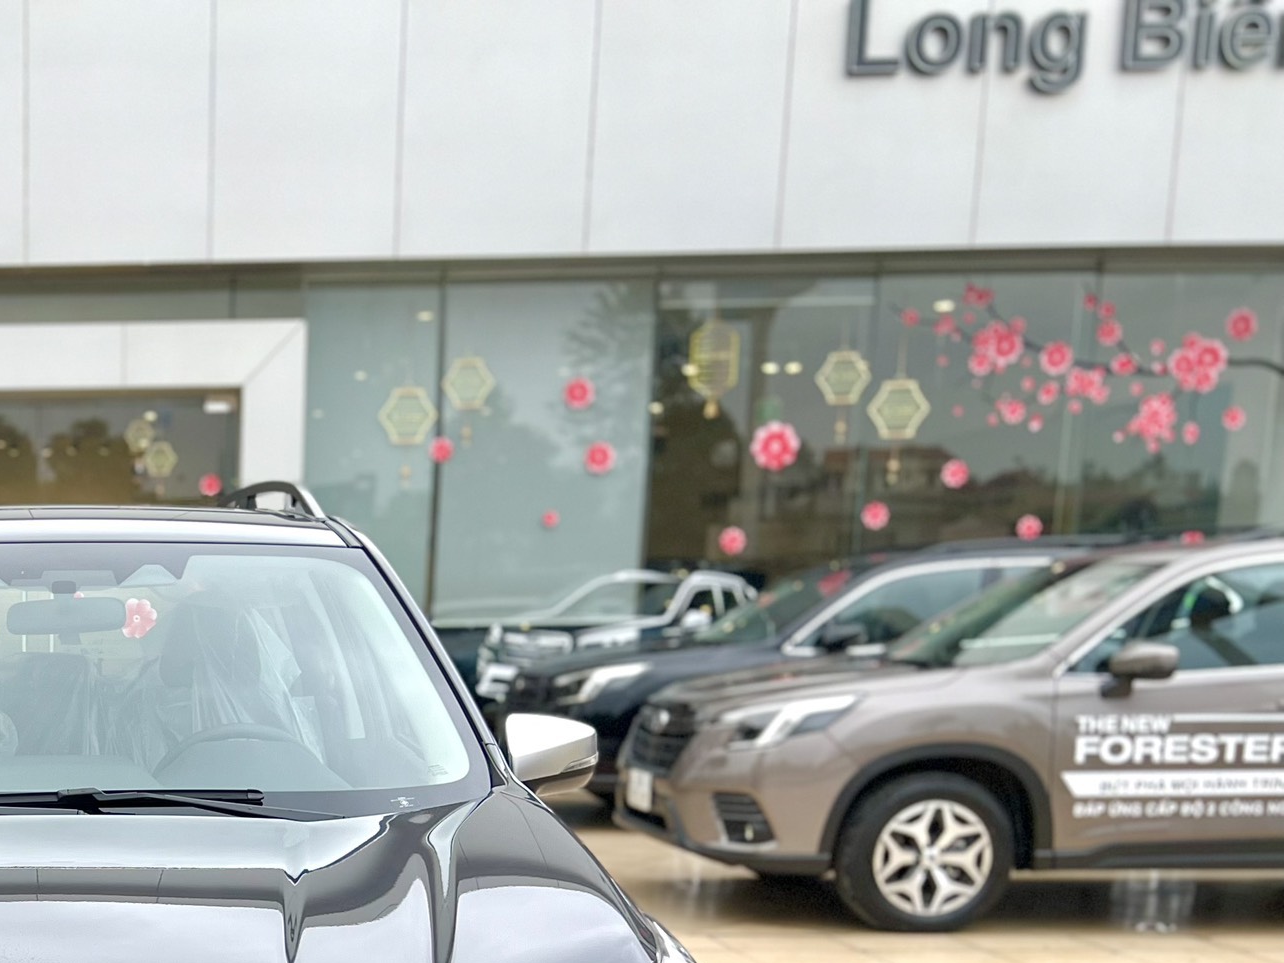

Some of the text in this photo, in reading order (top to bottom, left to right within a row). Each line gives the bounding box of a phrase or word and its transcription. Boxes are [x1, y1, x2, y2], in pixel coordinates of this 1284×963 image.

[846, 0, 1284, 95] Long Biê
[1076, 712, 1173, 734] THE NEW
